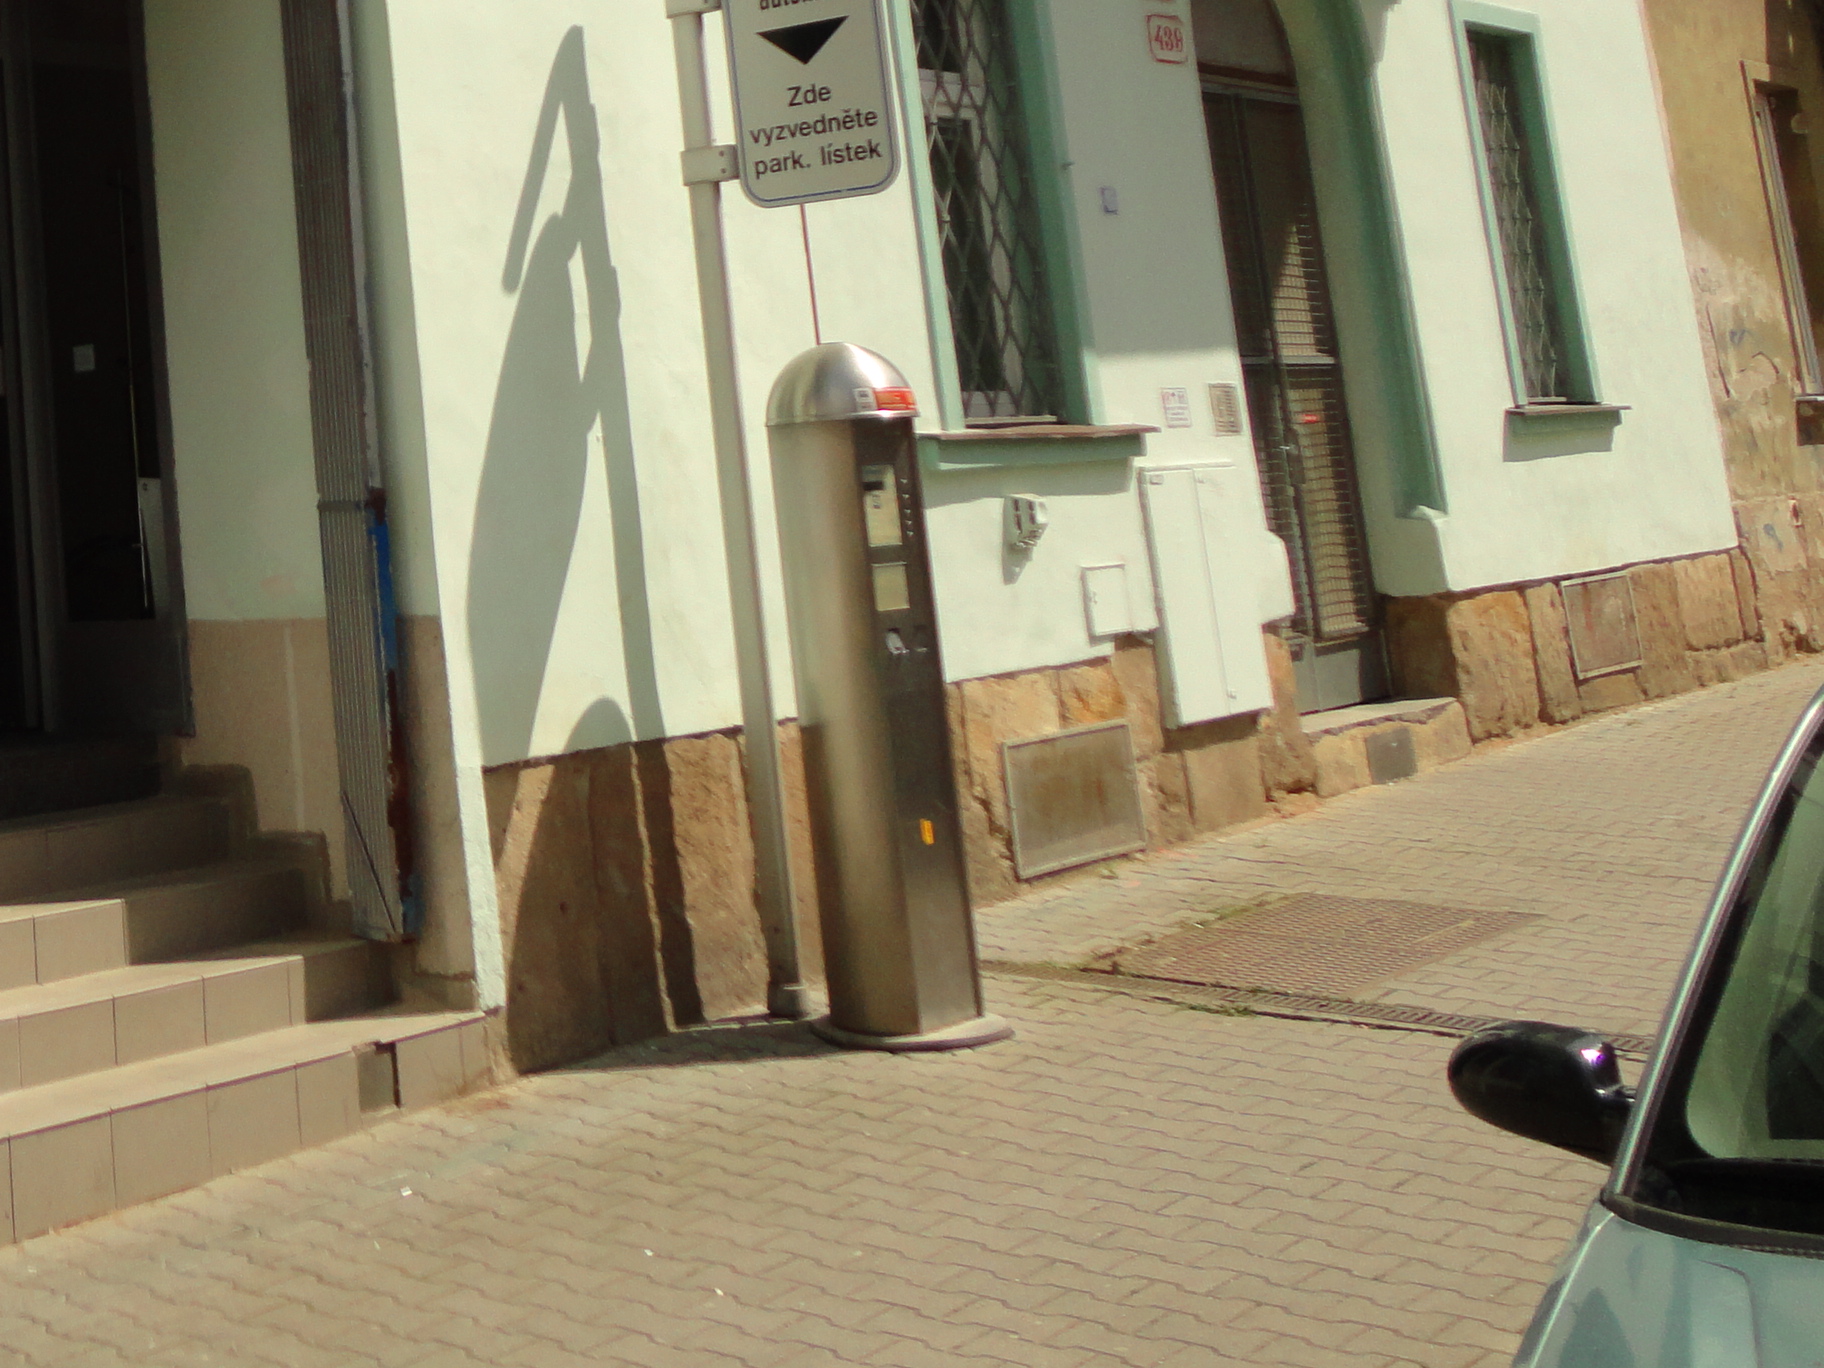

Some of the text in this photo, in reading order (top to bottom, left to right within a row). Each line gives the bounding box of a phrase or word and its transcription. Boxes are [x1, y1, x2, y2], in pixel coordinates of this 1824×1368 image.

[787, 83, 832, 107] Zde
[749, 107, 878, 148] vyzvedněte
[754, 138, 883, 180] park. lístek
